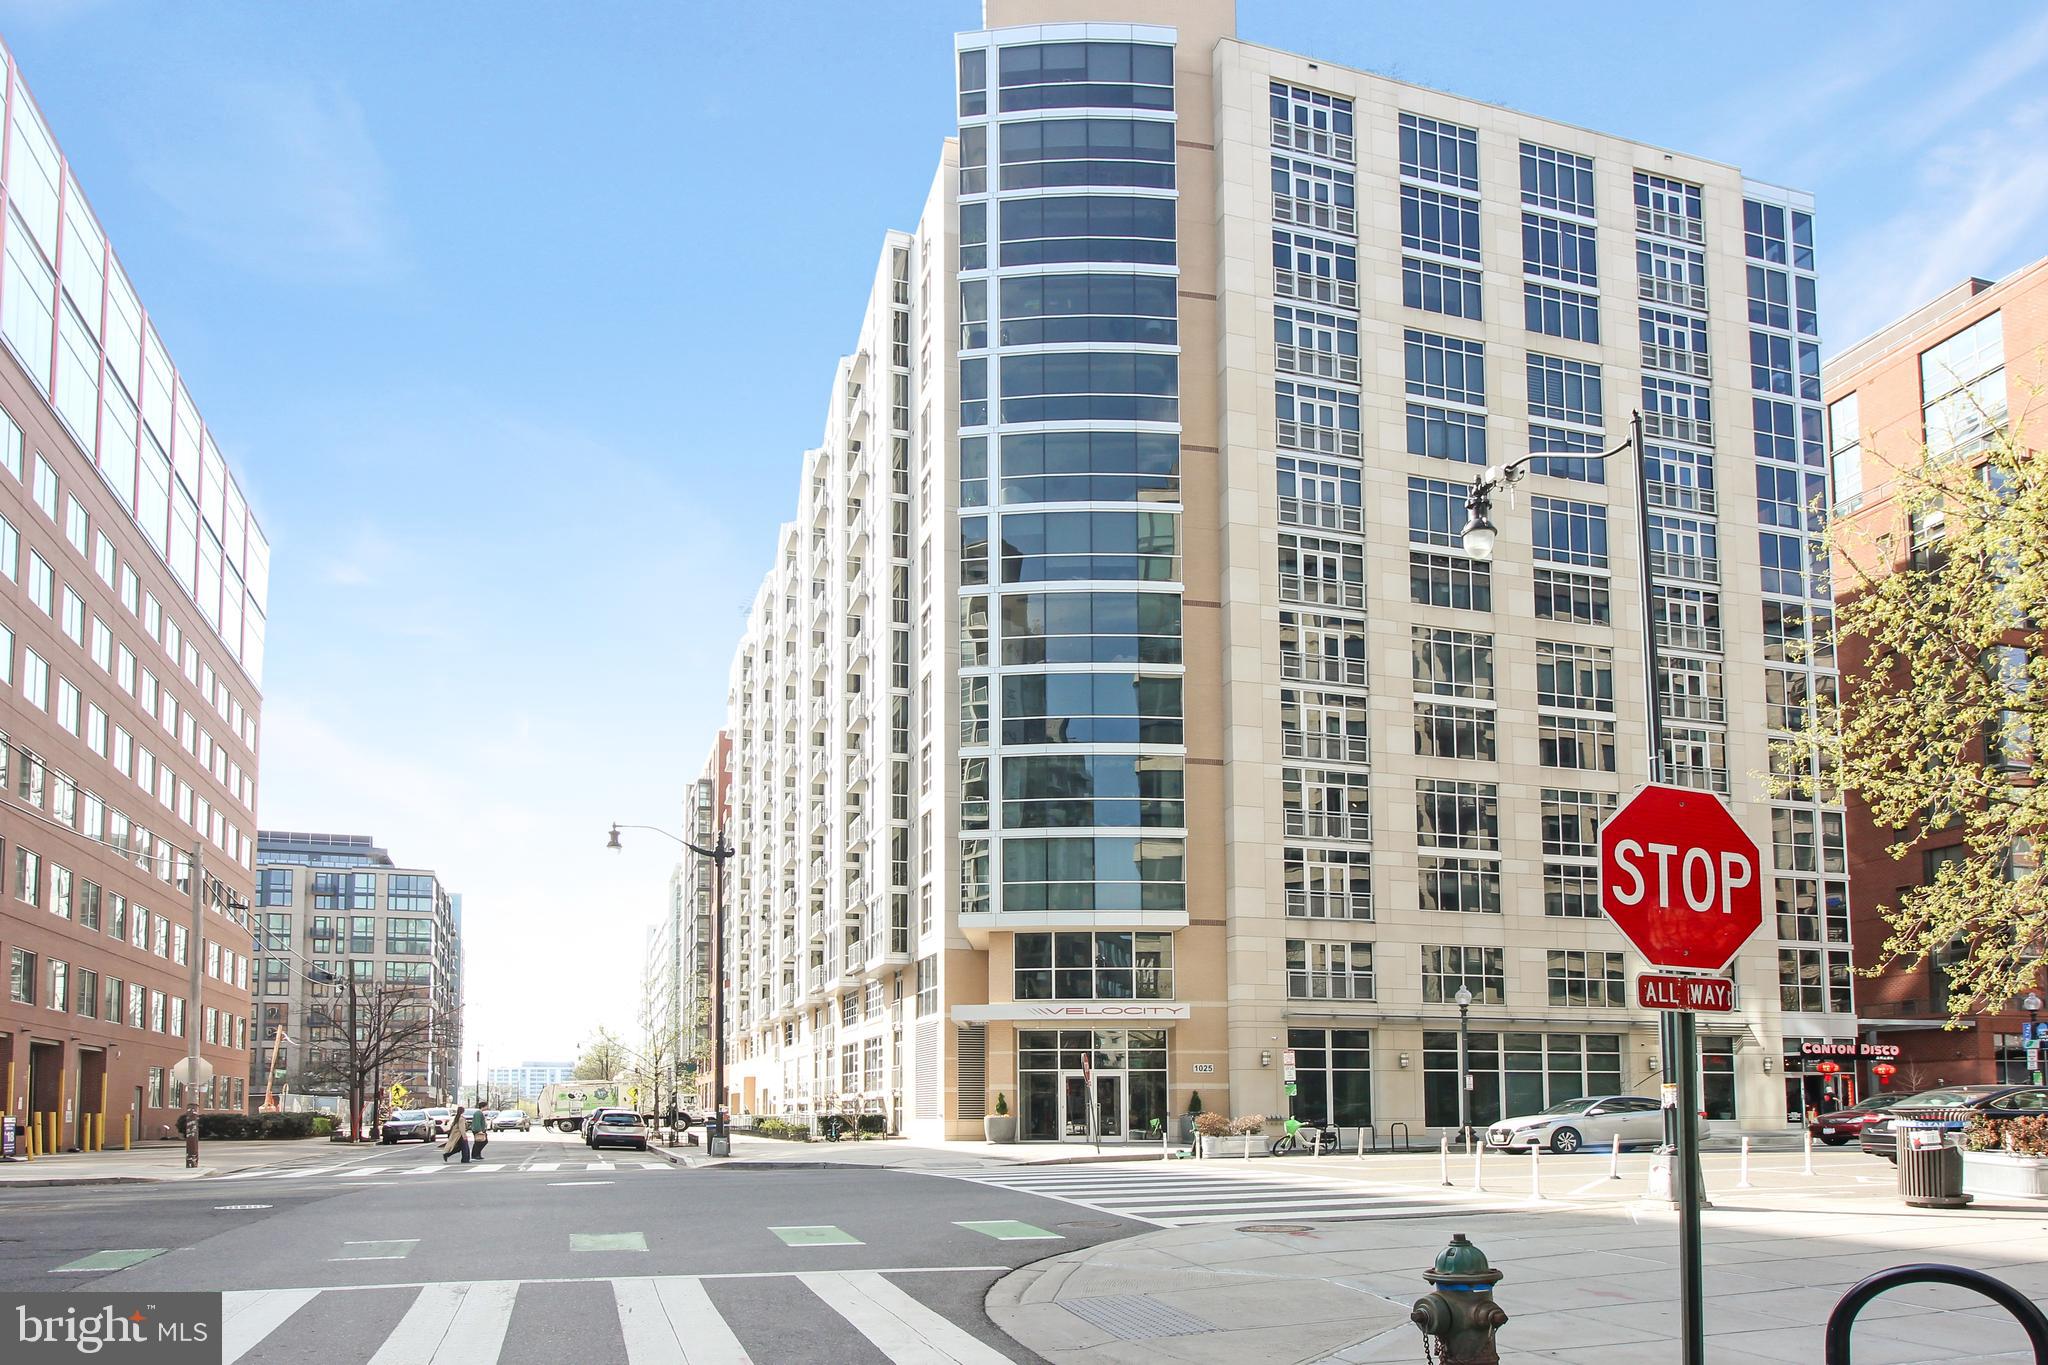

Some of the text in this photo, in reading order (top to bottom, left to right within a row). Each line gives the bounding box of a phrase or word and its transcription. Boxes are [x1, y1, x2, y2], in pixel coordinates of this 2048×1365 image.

[1612, 838, 1752, 914] STOP
[1646, 982, 1725, 1006] ALL WAY
[1046, 1007, 1183, 1015] VELOCITY
[1860, 1044, 1899, 1056] DISCO
[1194, 1064, 1212, 1072] 1025
